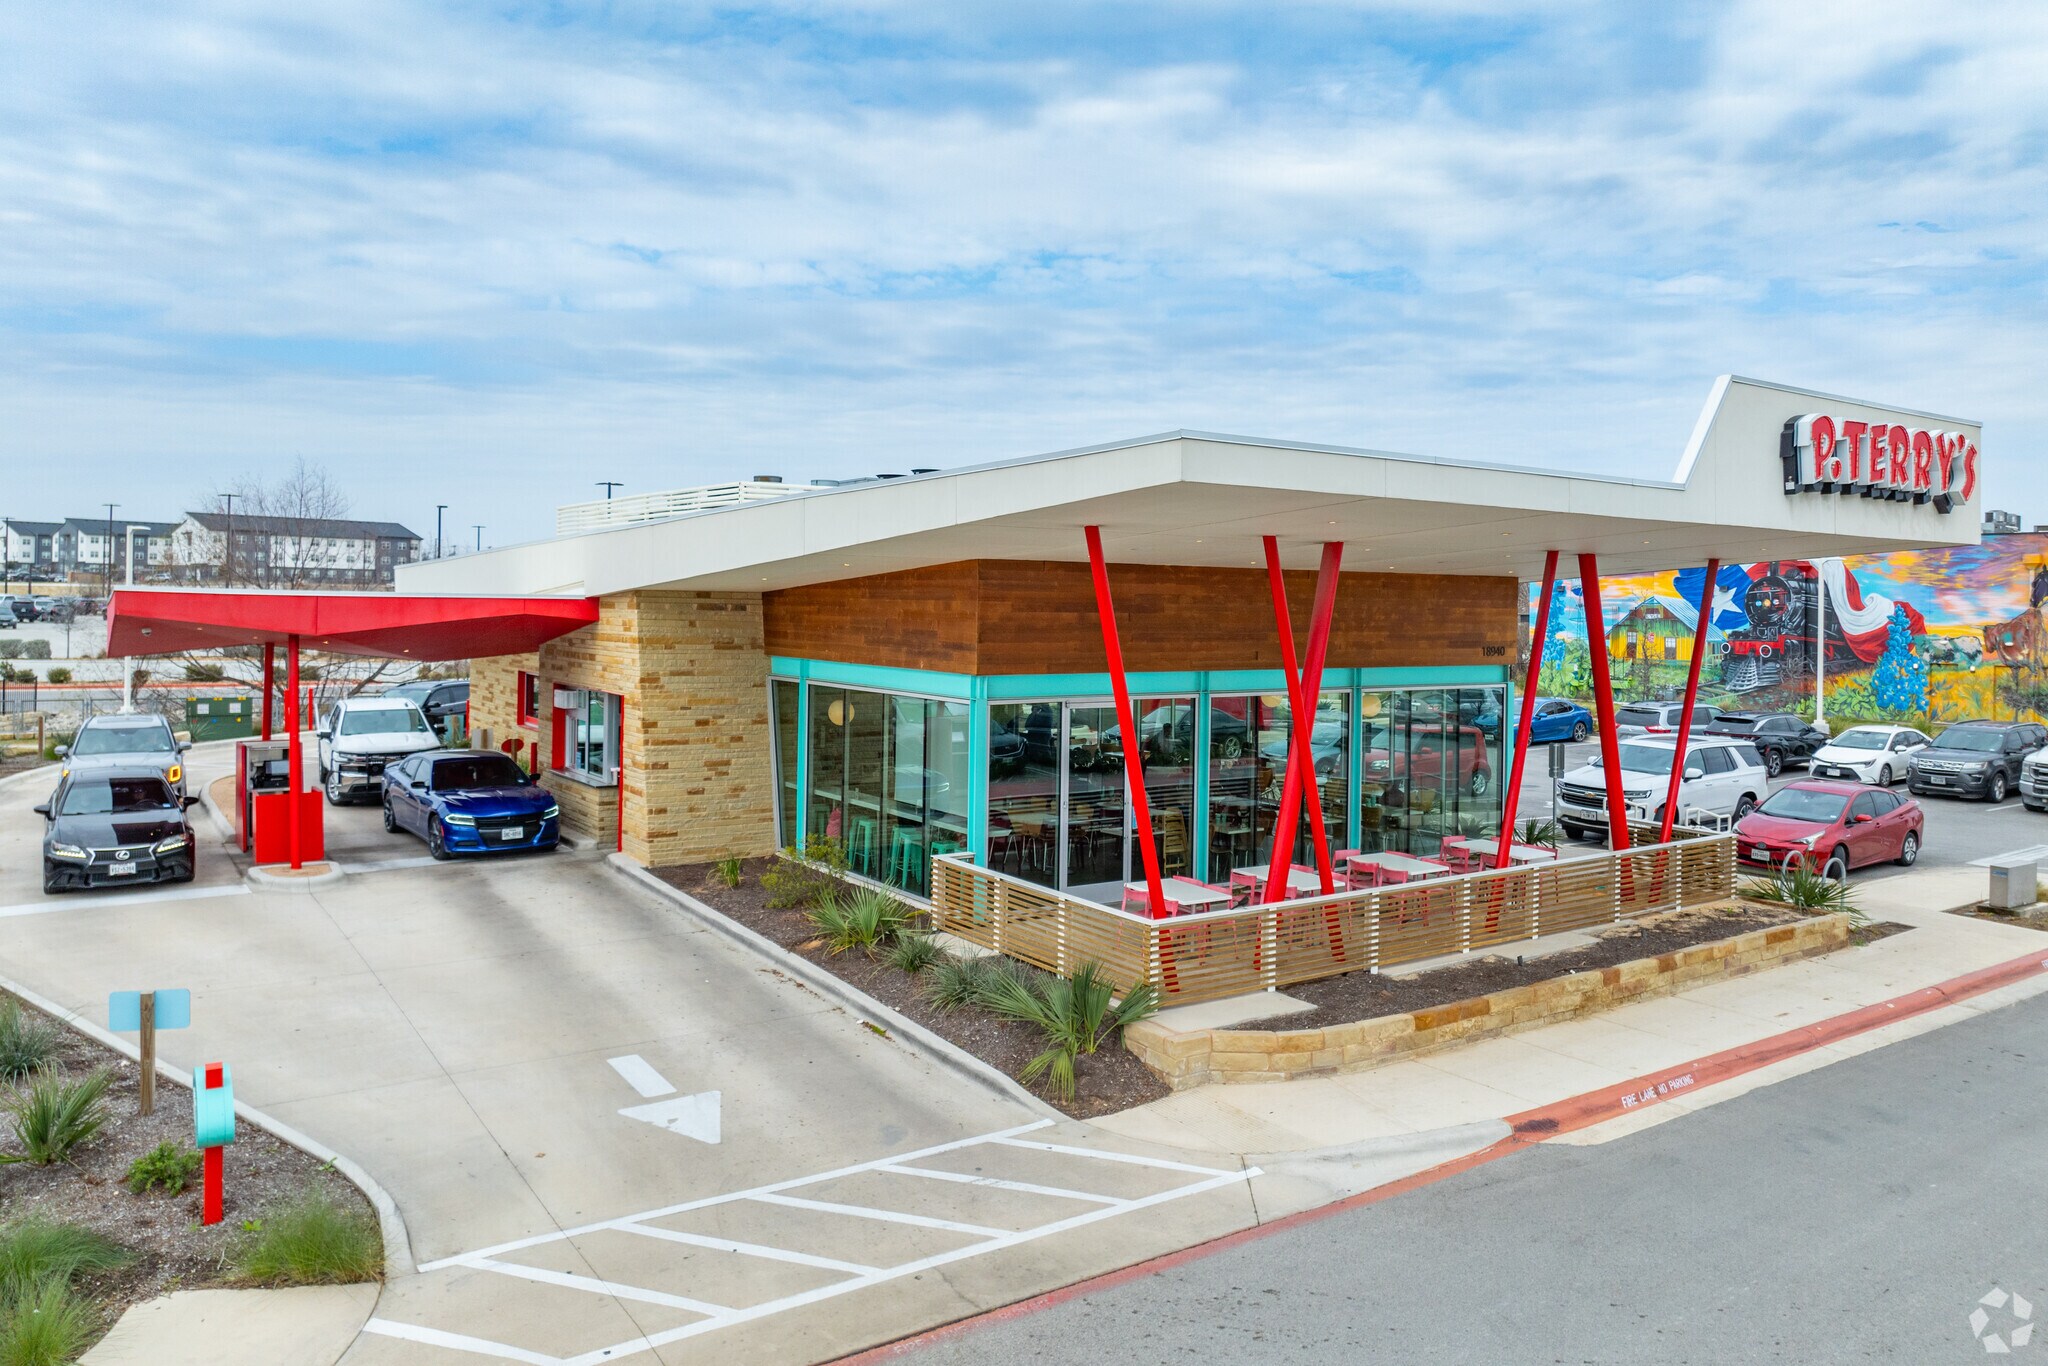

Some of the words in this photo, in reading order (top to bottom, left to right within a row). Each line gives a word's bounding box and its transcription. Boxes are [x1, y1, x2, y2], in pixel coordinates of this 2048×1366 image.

[1482, 646, 1506, 657] 18940
[1621, 1093, 1638, 1109] FIRE
[1638, 1086, 1657, 1102] LANE
[1658, 1083, 1668, 1095] NO
[1668, 1074, 1694, 1091] PARKING
